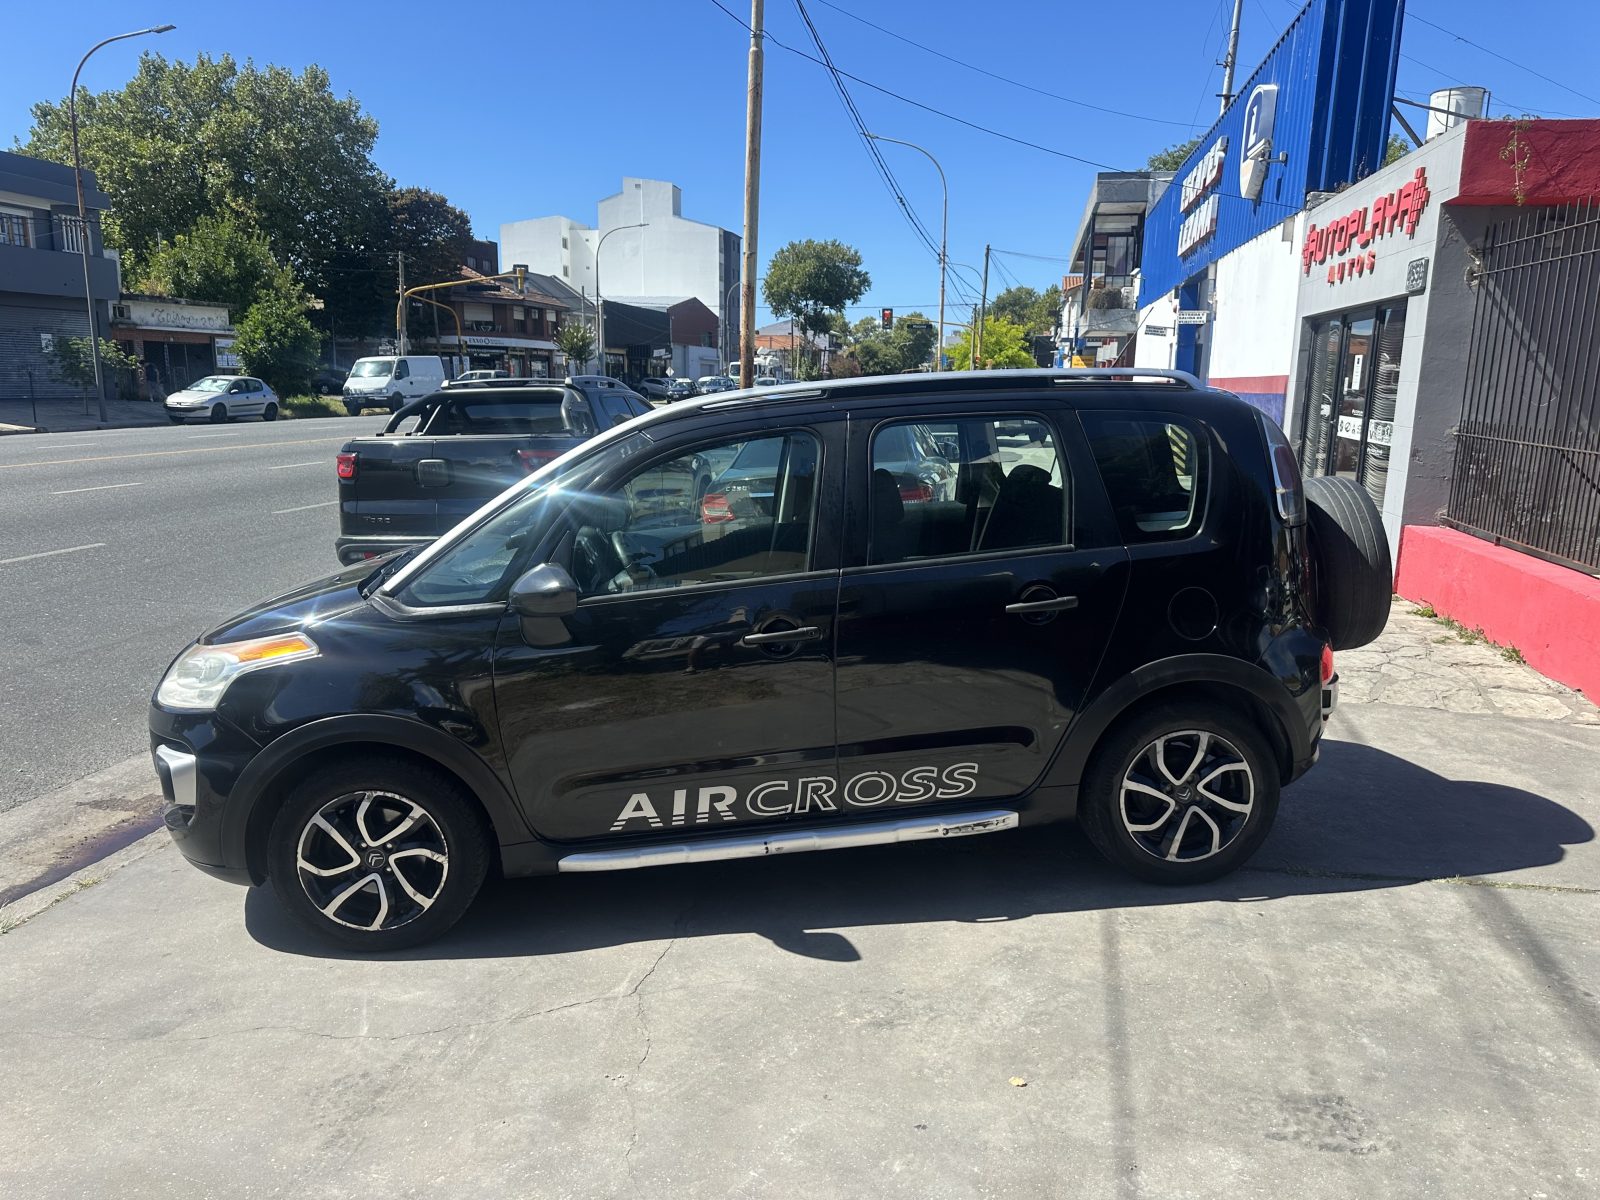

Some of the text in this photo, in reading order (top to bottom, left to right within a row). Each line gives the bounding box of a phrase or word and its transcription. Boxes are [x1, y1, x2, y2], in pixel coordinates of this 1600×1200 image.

[1307, 179, 1418, 267] AUTOPLAYA
[1327, 250, 1377, 287] AUTOS
[609, 762, 979, 831] AIRCROSS
